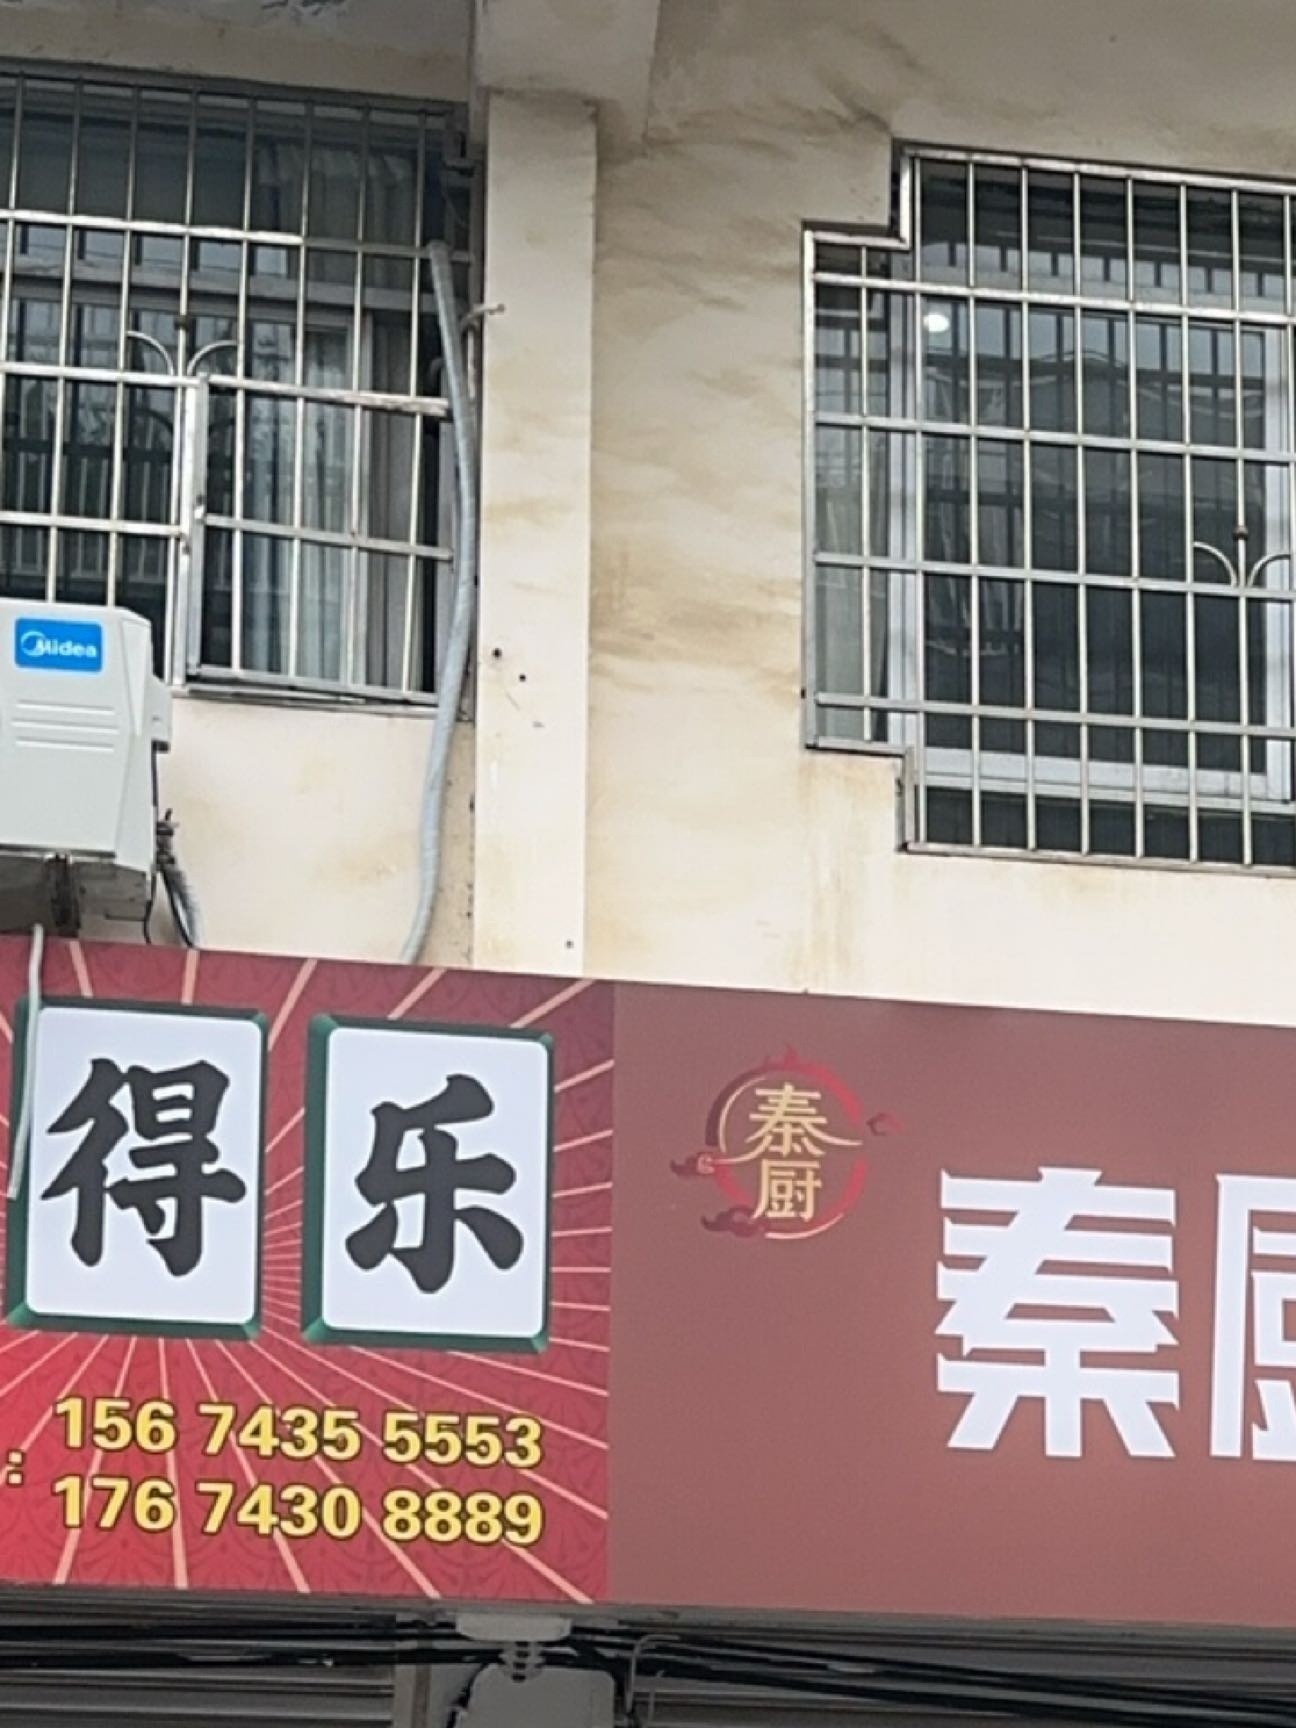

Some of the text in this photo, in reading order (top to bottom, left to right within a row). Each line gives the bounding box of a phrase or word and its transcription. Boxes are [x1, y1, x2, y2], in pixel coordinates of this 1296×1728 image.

[28, 634, 97, 657] Midea
[42, 1059, 523, 1292] 得乐
[54, 1397, 543, 1468] 156 7435 5553
[53, 1476, 543, 1545] 176 7430 8889
